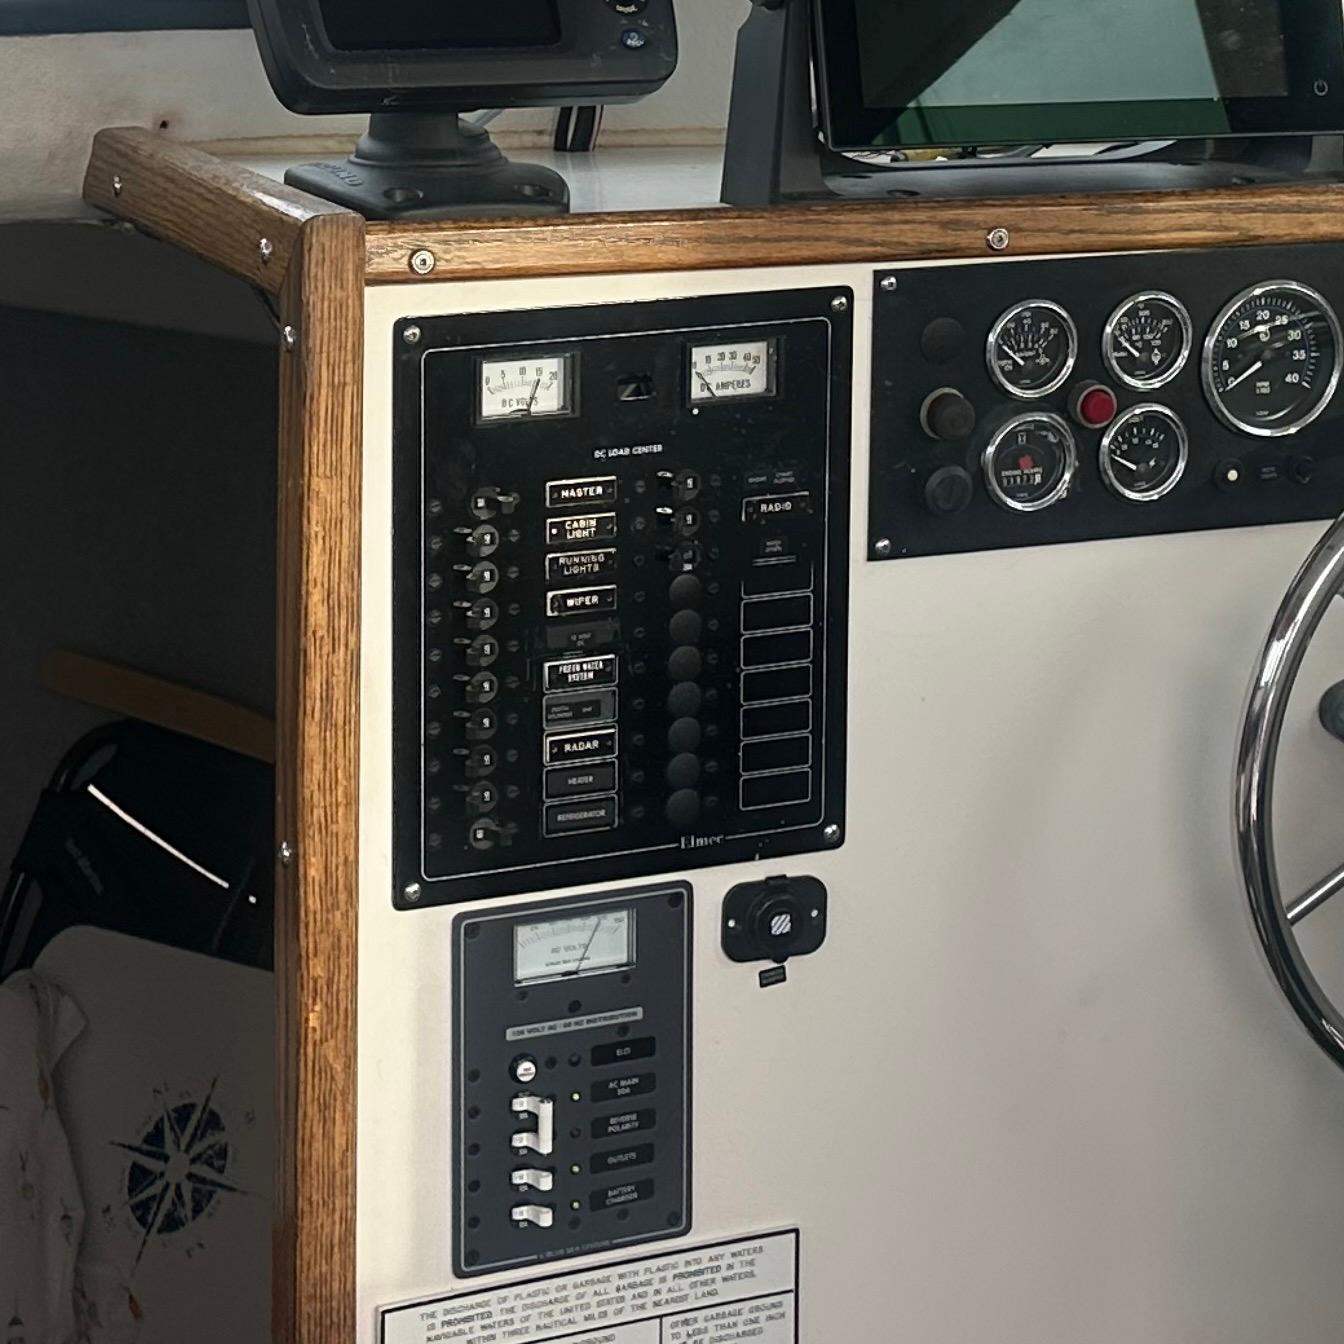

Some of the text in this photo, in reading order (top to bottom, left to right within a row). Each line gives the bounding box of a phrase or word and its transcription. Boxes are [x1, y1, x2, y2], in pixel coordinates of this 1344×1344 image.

[1256, 309, 1270, 321] 20
[1287, 330, 1302, 341] 30
[1226, 337, 1238, 349] 10
[1292, 349, 1307, 361] 35
[1284, 373, 1300, 384] 40
[561, 485, 604, 498] MASTER
[565, 518, 597, 530] CABIN
[567, 528, 597, 540] LIGHT
[559, 552, 605, 566] RUNNING
[566, 594, 599, 607] WIPER
[564, 739, 600, 753] RADAR
[514, 1286, 551, 1302] PLASTIC
[643, 1261, 680, 1275] PLASTIC
[730, 1245, 764, 1258] WATERS
[441, 1310, 493, 1329] PROHIBITED
[593, 1287, 610, 1297] ALL
[672, 1264, 722, 1281] PROHIBITED
[480, 1318, 515, 1332] WATERS
[667, 1283, 684, 1294] ALL
